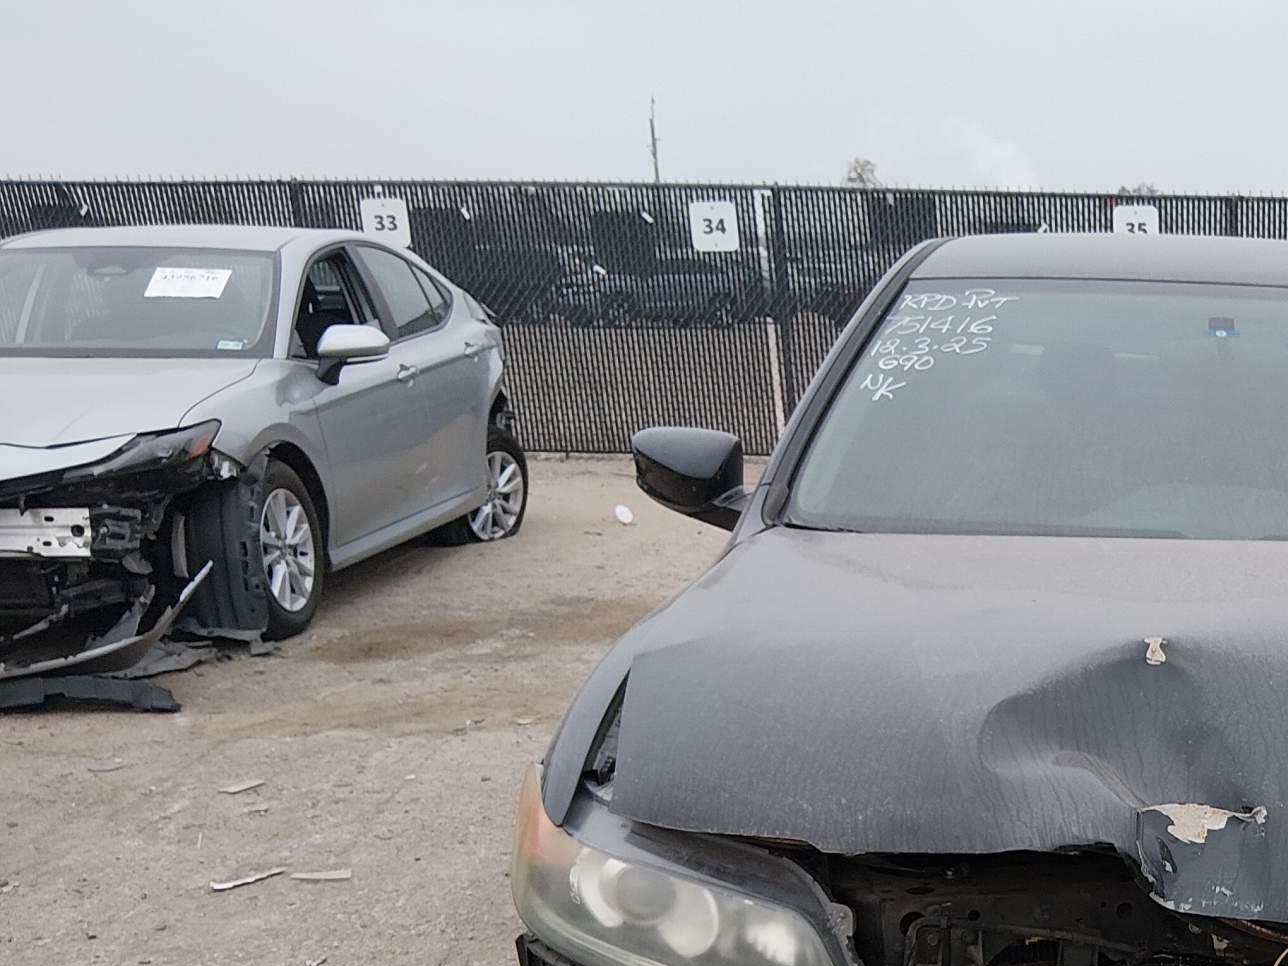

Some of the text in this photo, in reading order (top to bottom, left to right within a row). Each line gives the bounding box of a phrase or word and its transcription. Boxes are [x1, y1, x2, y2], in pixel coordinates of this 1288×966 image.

[374, 215, 398, 231] 33
[703, 218, 727, 234] 34
[885, 316, 997, 335] 751416
[860, 374, 907, 401] NK
